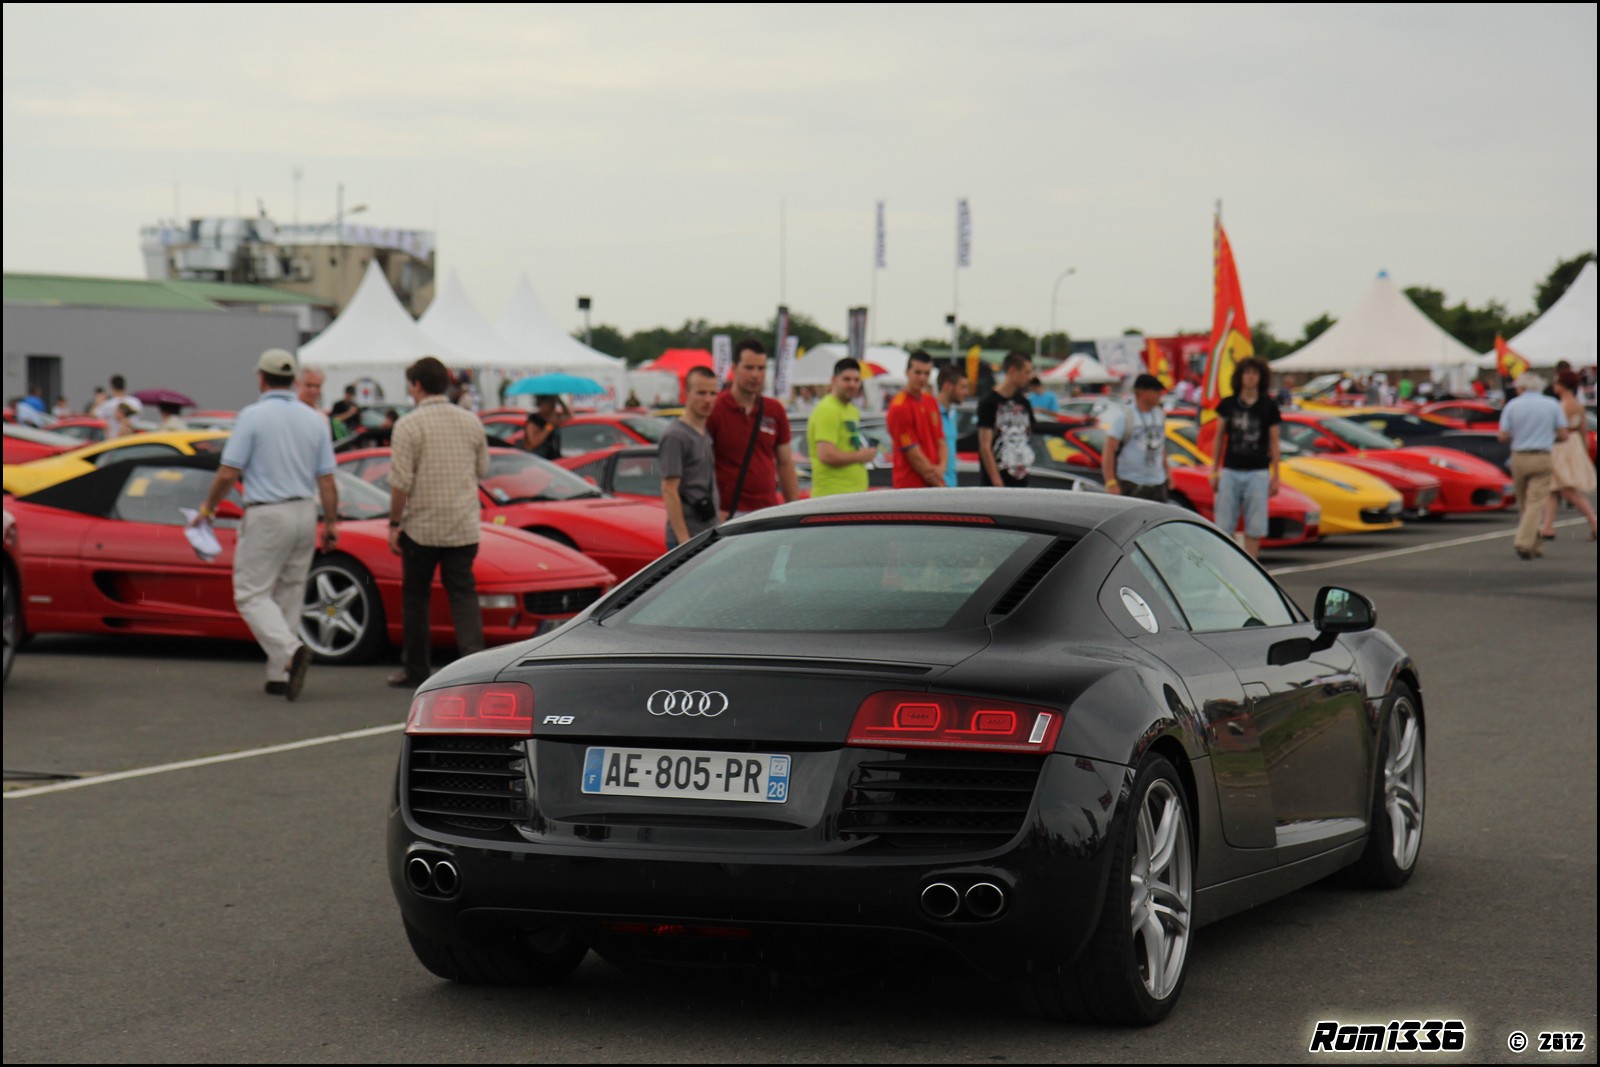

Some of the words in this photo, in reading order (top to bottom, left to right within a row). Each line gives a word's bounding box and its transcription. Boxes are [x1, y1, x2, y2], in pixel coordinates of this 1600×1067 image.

[543, 715, 576, 725] R8
[589, 774, 598, 785] F
[604, 752, 763, 794] AE-805-PR
[767, 781, 786, 798] 28
